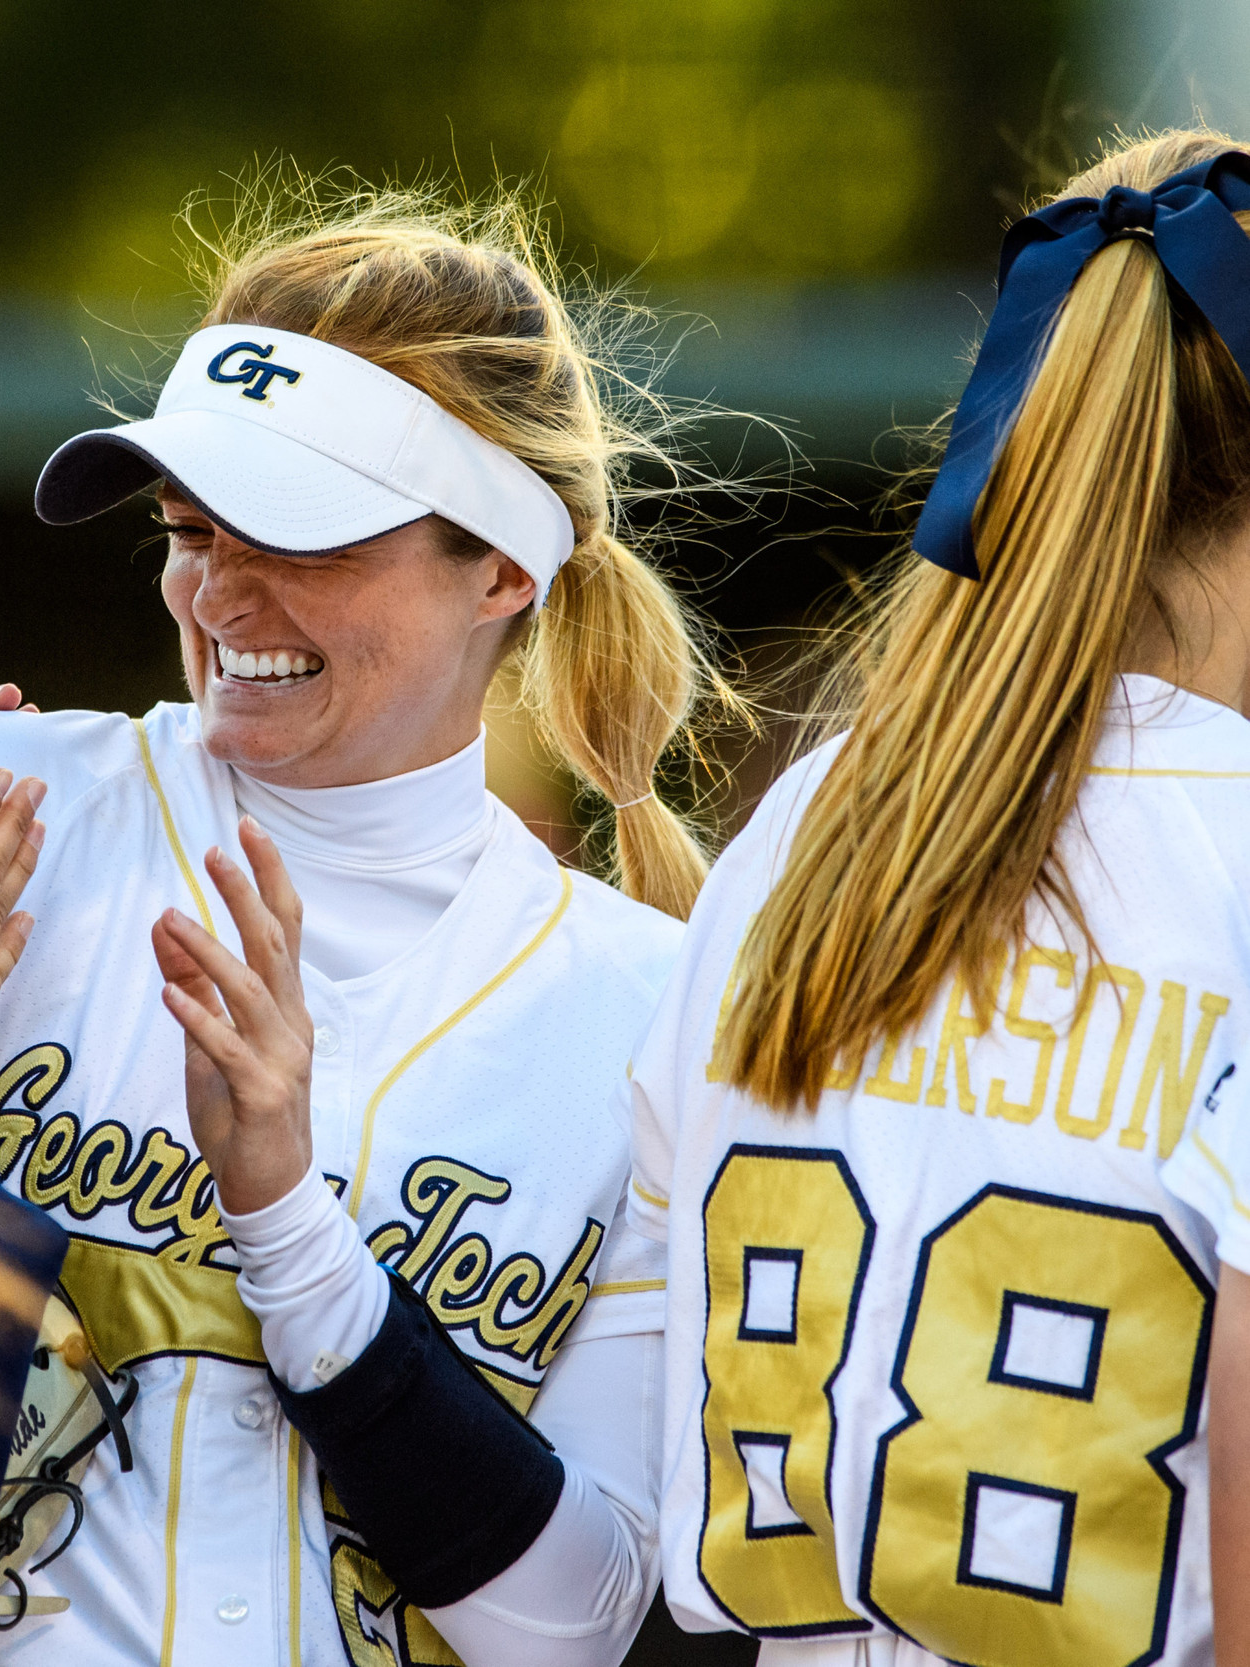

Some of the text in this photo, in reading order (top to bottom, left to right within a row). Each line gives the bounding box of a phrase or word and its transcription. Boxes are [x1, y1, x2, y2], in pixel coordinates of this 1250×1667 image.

[207, 341, 304, 405] GT
[705, 914, 1232, 1160] RSON
[365, 1155, 606, 1371] Tech
[698, 1143, 1218, 1667] 88
